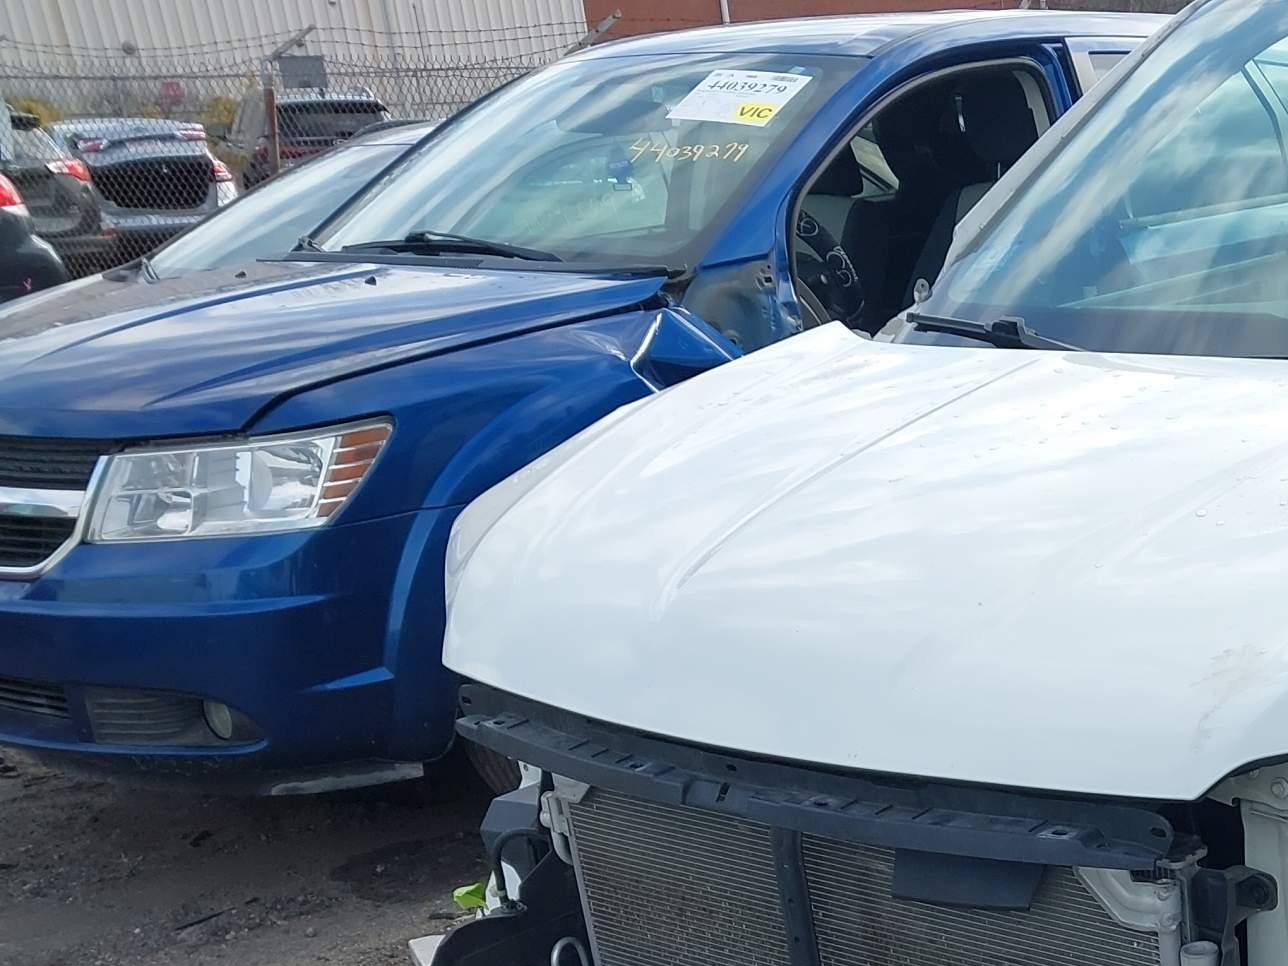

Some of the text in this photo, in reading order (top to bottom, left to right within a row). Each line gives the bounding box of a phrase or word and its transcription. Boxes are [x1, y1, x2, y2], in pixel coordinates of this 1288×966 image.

[707, 80, 788, 95] 44039279
[739, 106, 773, 119] VIC
[630, 136, 750, 163] 44039279
